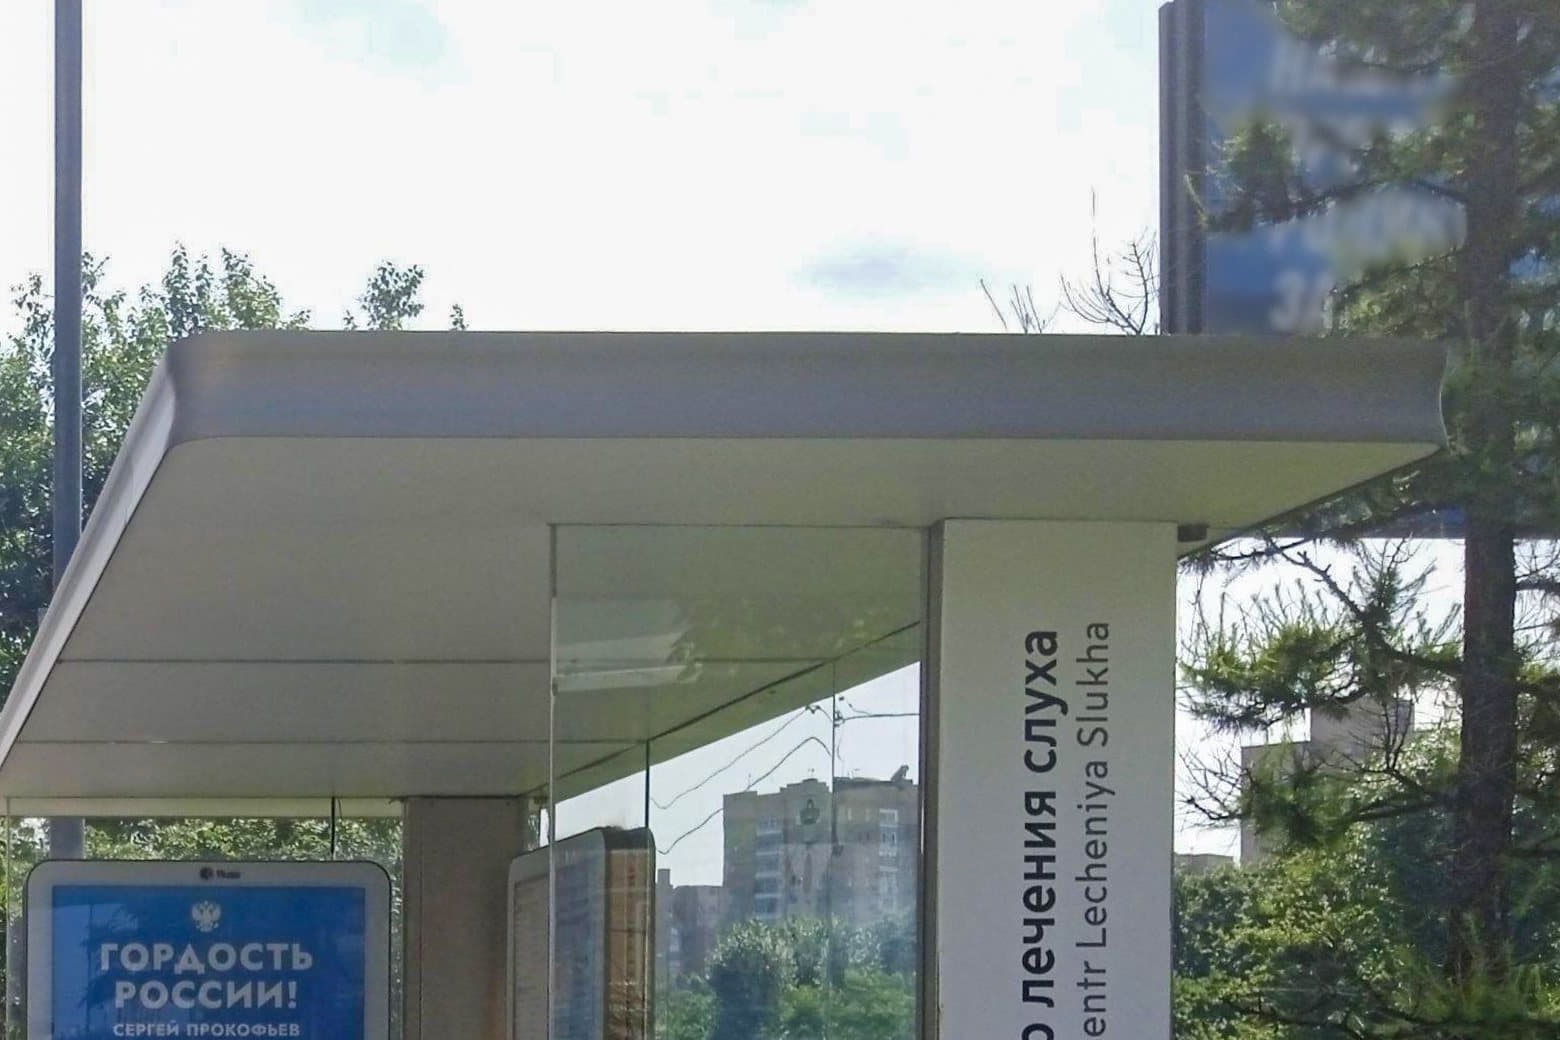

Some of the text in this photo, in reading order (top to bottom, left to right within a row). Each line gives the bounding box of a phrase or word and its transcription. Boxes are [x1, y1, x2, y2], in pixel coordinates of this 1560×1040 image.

[1023, 629, 1069, 774] слуха
[1075, 621, 1110, 747] Slukha
[1021, 791, 1057, 1008] лечения
[1074, 761, 1116, 948] Lecheniya
[100, 942, 313, 975] ГОРДОСТЬ
[114, 980, 298, 1009] РОССИИ!
[112, 1019, 301, 1037] СЕРГЕЙ ПРОКОФЬЕВ
